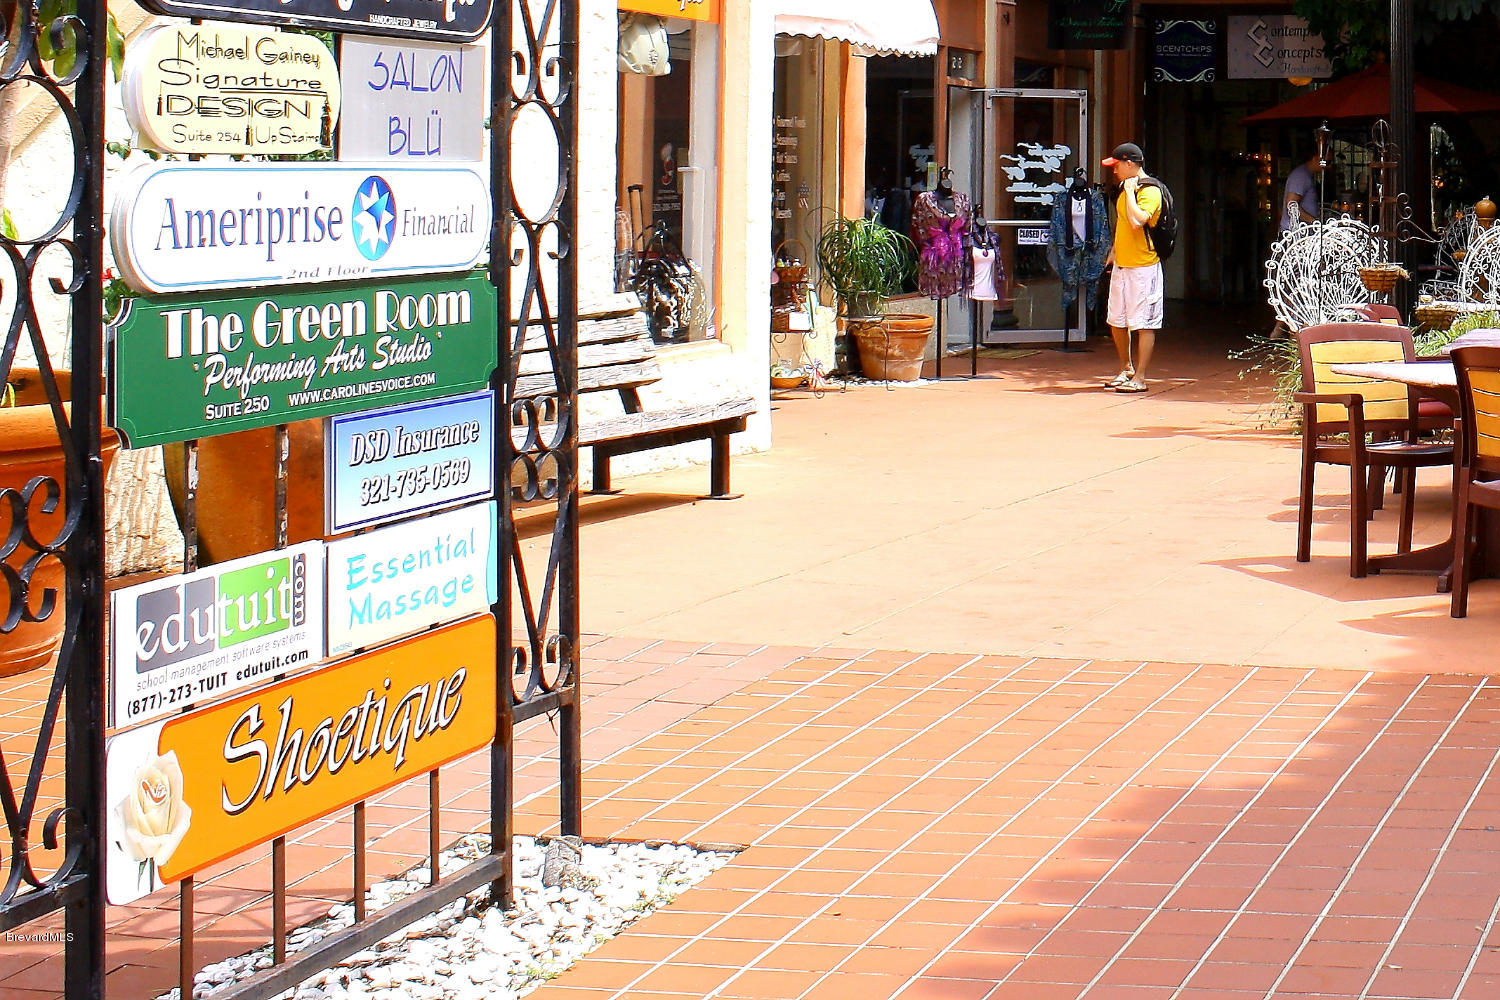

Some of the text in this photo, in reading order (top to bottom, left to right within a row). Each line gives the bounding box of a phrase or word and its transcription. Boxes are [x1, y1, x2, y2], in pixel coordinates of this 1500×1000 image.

[158, 58, 322, 88] Signature
[177, 31, 321, 69] Michael Gainey
[367, 47, 463, 93] SALON
[166, 94, 311, 119] DESIGN
[172, 124, 212, 144] Suite
[217, 132, 242, 142] 254
[388, 110, 441, 156] BLÜ
[154, 190, 474, 262] Ameriprise Financial
[1019, 229, 1040, 238] CLOSED
[286, 265, 369, 280] 2nd Floor
[159, 289, 472, 359] The Green Room
[203, 332, 433, 399] Performing Arts Studio
[205, 372, 436, 420] SUITE 250 WWW.CAROLINESVOICE.COM
[349, 420, 480, 466] DSD Insurance
[360, 457, 471, 506] 321-735-0569
[346, 527, 475, 590] Essential
[136, 567, 291, 661] edutuit
[348, 574, 475, 630] Massage
[127, 650, 309, 718] (877)-273-TUIT edutuit.com
[136, 668, 168, 692] school
[171, 653, 229, 682] management
[232, 638, 270, 663] software
[272, 631, 307, 650] systems
[221, 666, 467, 815] Shoetique
